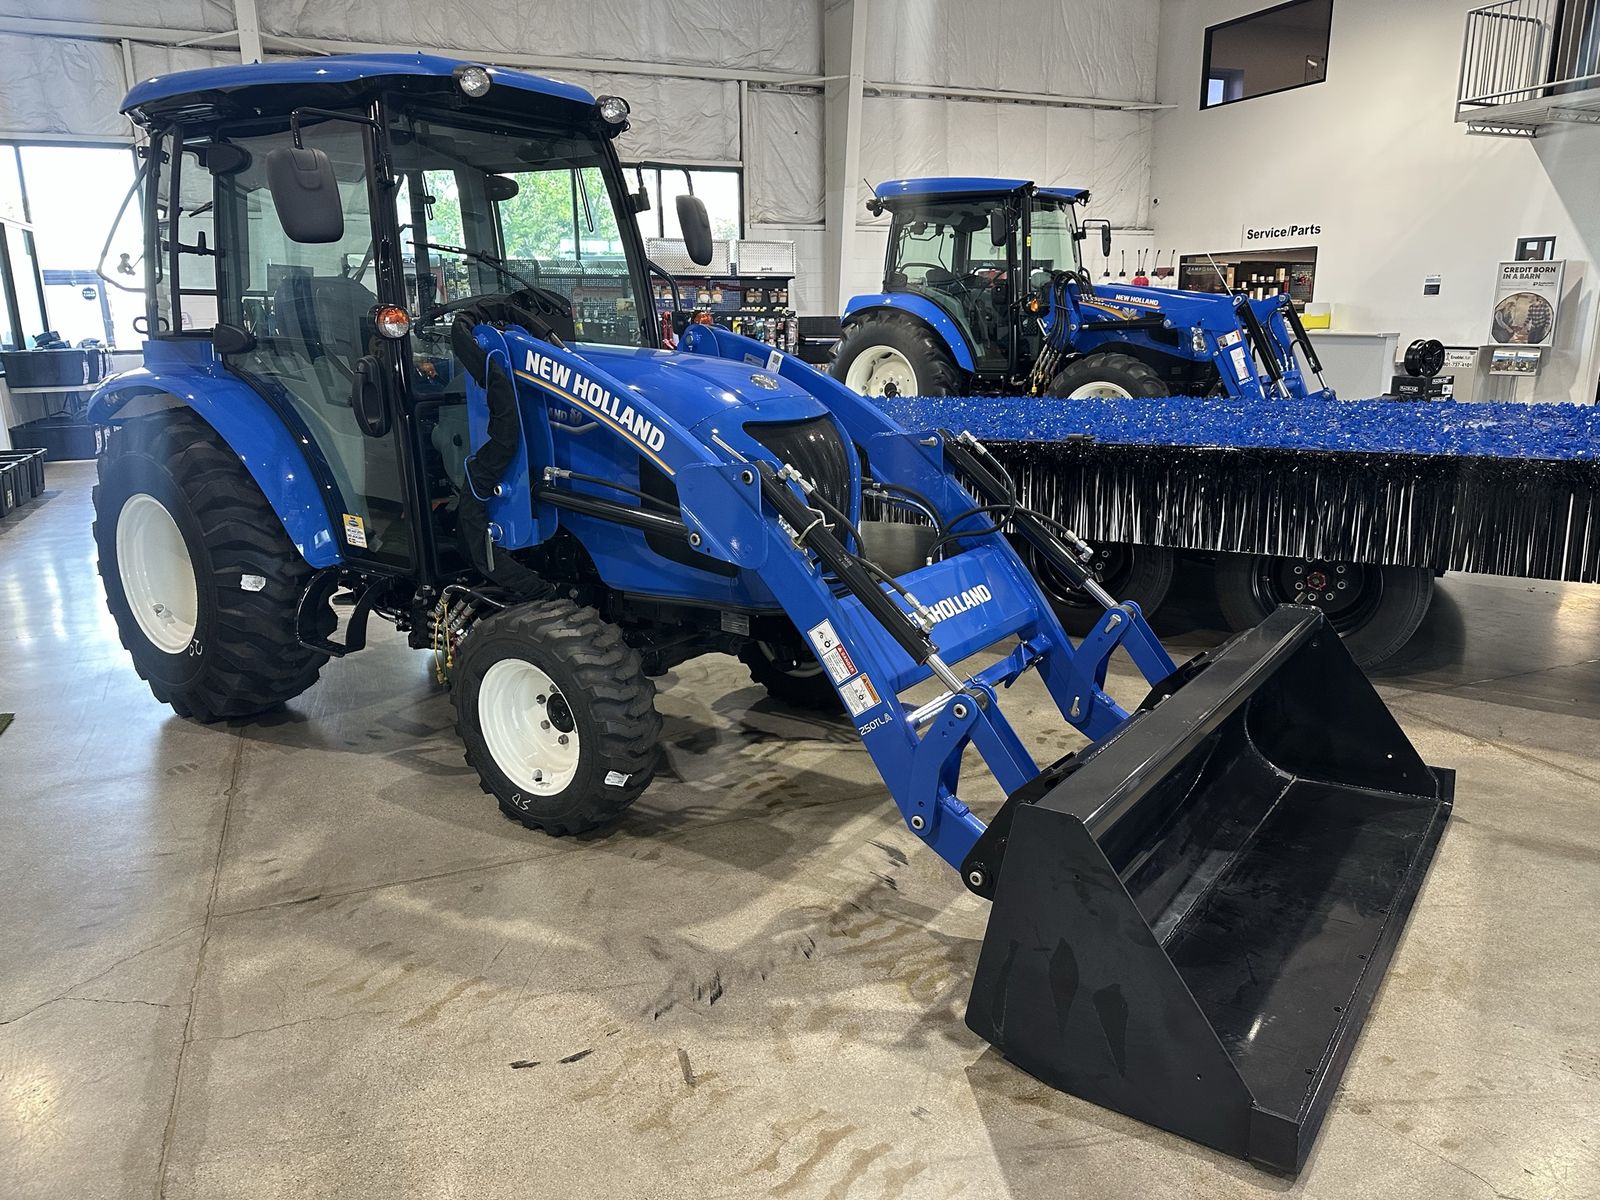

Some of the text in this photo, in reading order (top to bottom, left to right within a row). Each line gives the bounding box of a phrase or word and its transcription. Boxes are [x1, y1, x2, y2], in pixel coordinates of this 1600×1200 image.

[1247, 224, 1321, 240] Service/Parts
[1115, 294, 1130, 302] NEW
[1130, 295, 1159, 306] HOLLAND
[525, 349, 665, 452] NEW HOLLAND
[929, 584, 992, 623] HOLLAND
